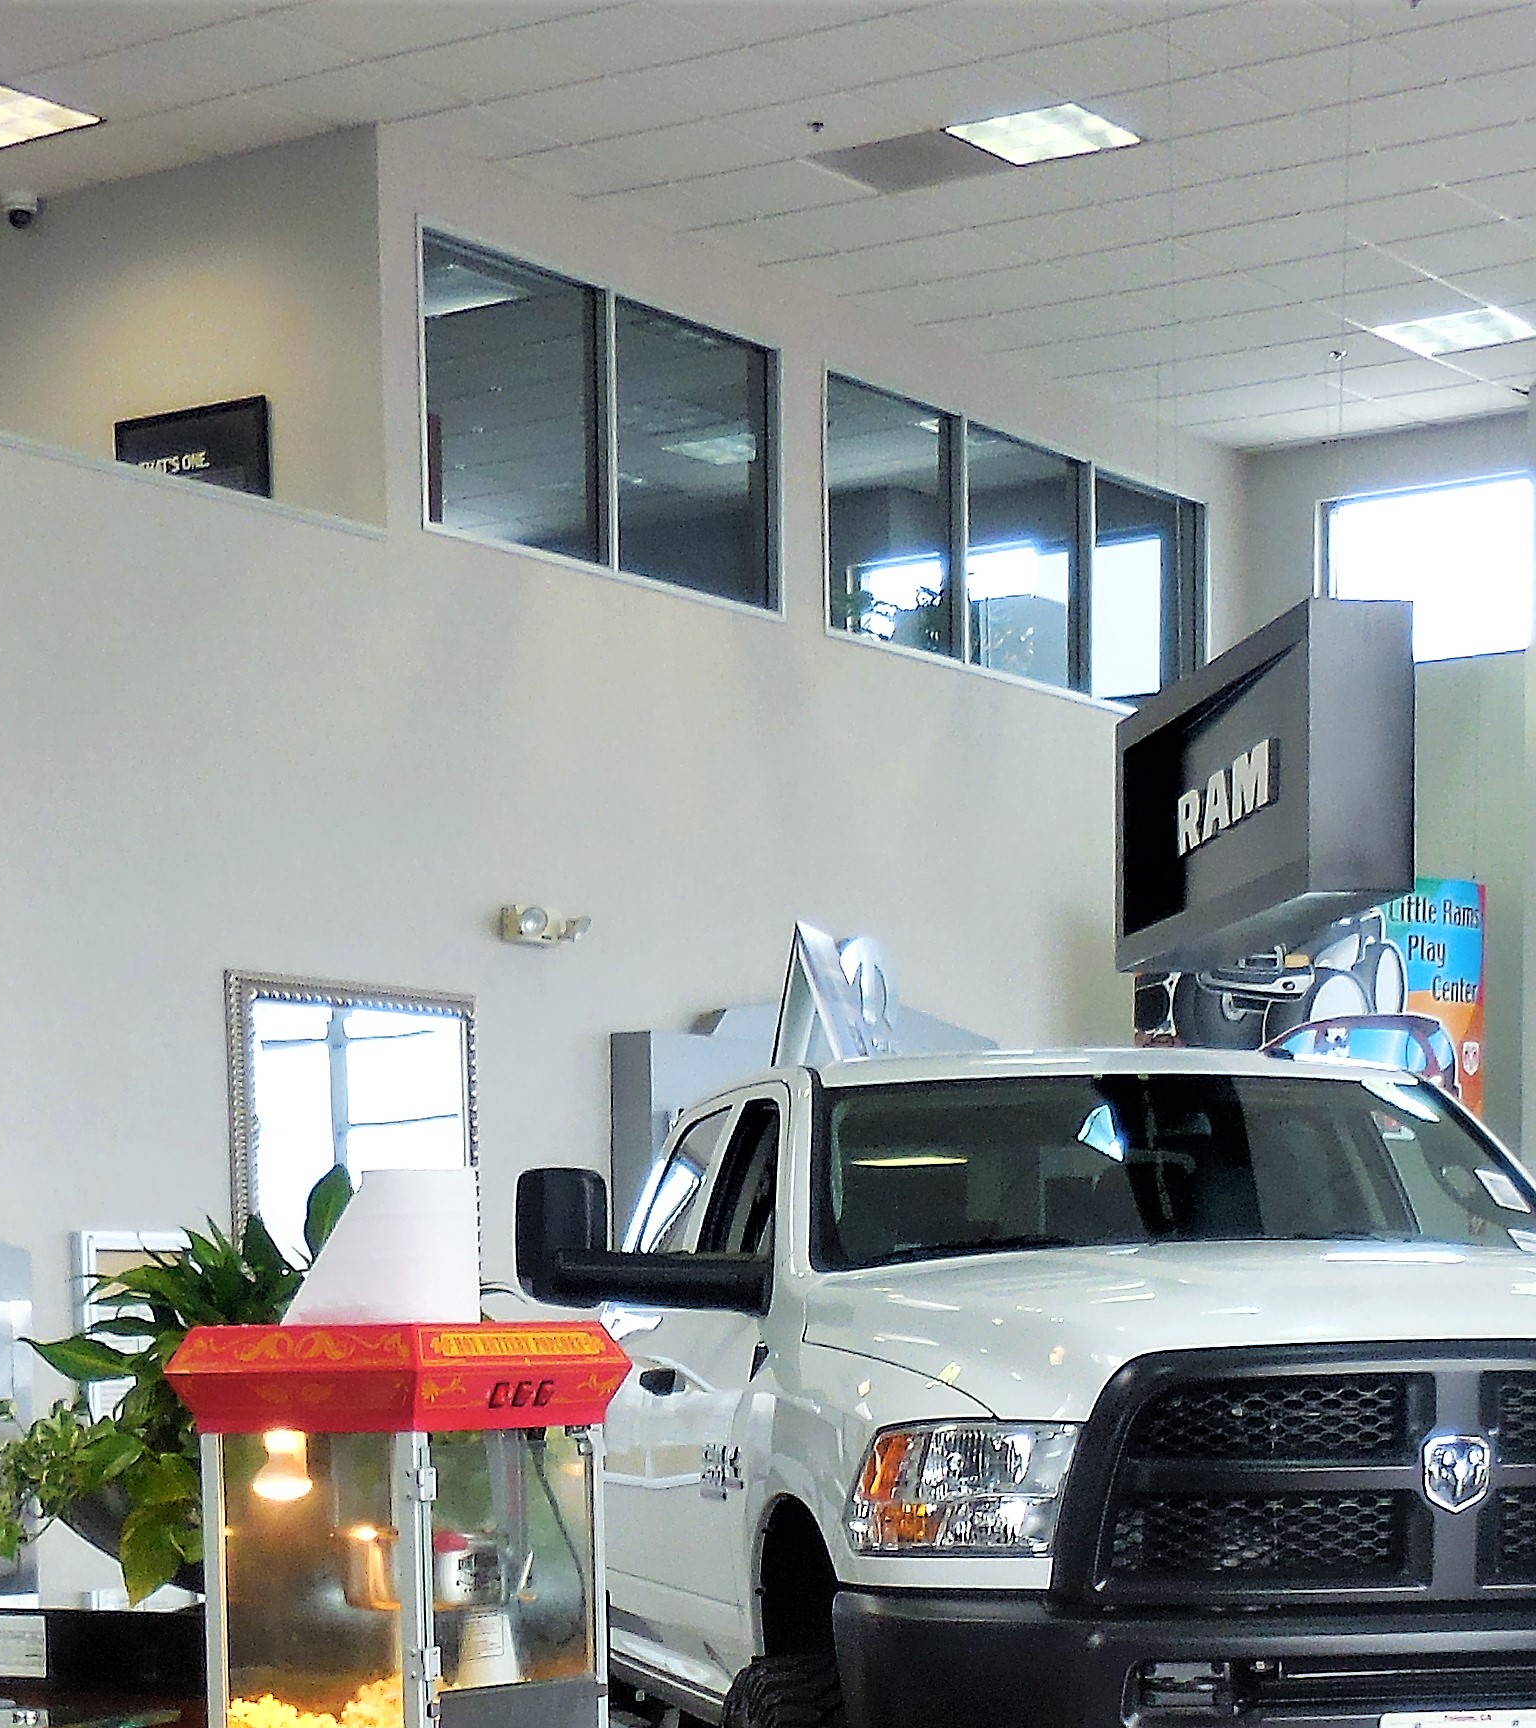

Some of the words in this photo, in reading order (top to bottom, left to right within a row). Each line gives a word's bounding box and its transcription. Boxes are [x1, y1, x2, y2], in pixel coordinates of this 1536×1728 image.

[1177, 739, 1270, 857] RAM
[1390, 896, 1437, 924] Little
[1443, 900, 1480, 929] Rams
[1408, 935, 1447, 968] Play
[1432, 975, 1478, 1003] Center
